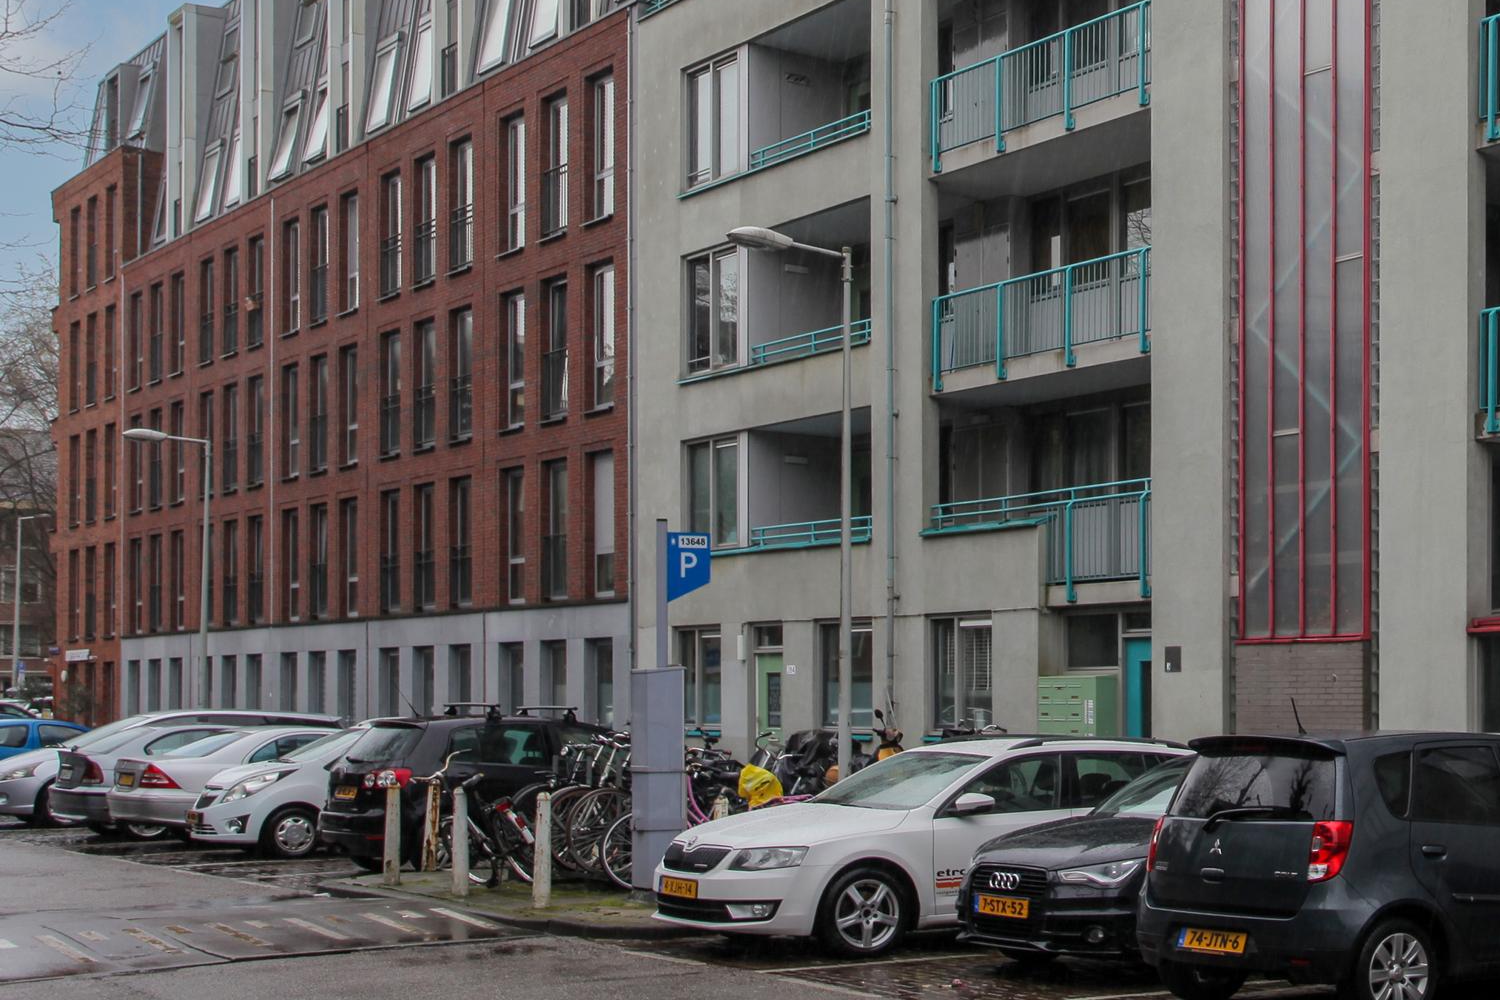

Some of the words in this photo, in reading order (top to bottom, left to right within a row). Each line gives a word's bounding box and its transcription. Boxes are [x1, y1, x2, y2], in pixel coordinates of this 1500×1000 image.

[681, 537, 706, 546] 13648
[680, 552, 698, 578] P
[983, 897, 1024, 915] 7-STX-52
[1189, 930, 1240, 950] 74-JTN-6
